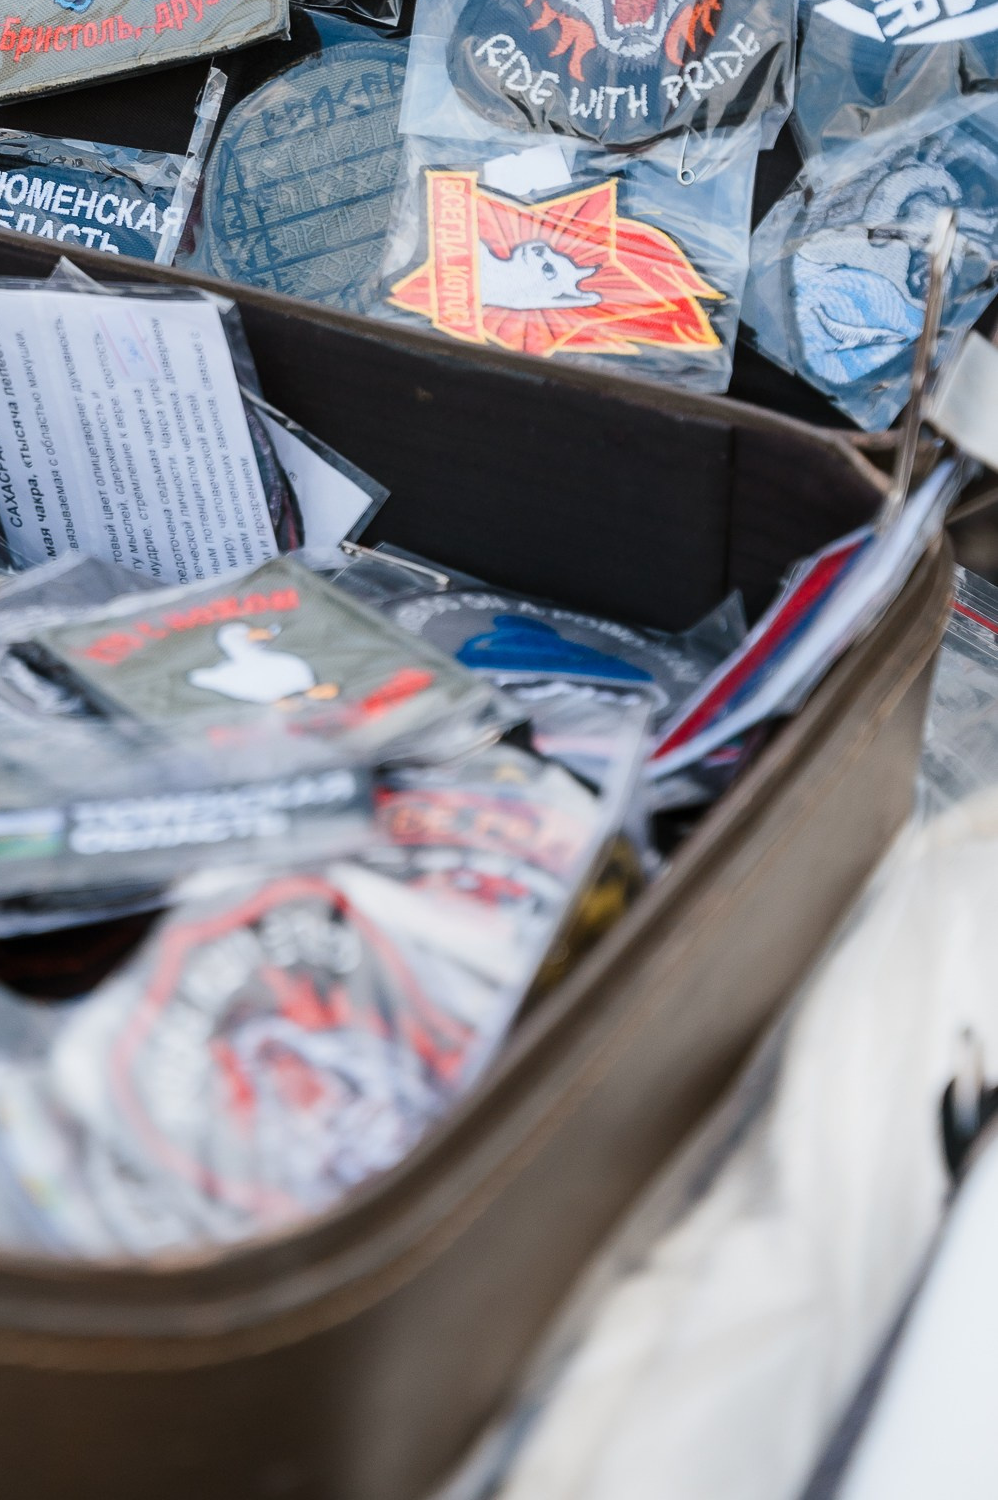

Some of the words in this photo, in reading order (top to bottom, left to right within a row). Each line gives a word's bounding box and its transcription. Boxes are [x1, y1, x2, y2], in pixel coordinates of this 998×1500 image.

[475, 34, 559, 106] RIDE
[570, 84, 648, 120] WITH
[661, 23, 762, 108] PRIDE
[437, 180, 469, 257] ВСЕГДА
[10, 401, 34, 469] «тысяча
[35, 392, 56, 455] областью
[74, 395, 105, 488] олицетворяет
[29, 473, 47, 522] чакра,
[52, 470, 80, 552] вязываемая
[101, 496, 115, 525] цвет
[126, 441, 149, 521] стремление
